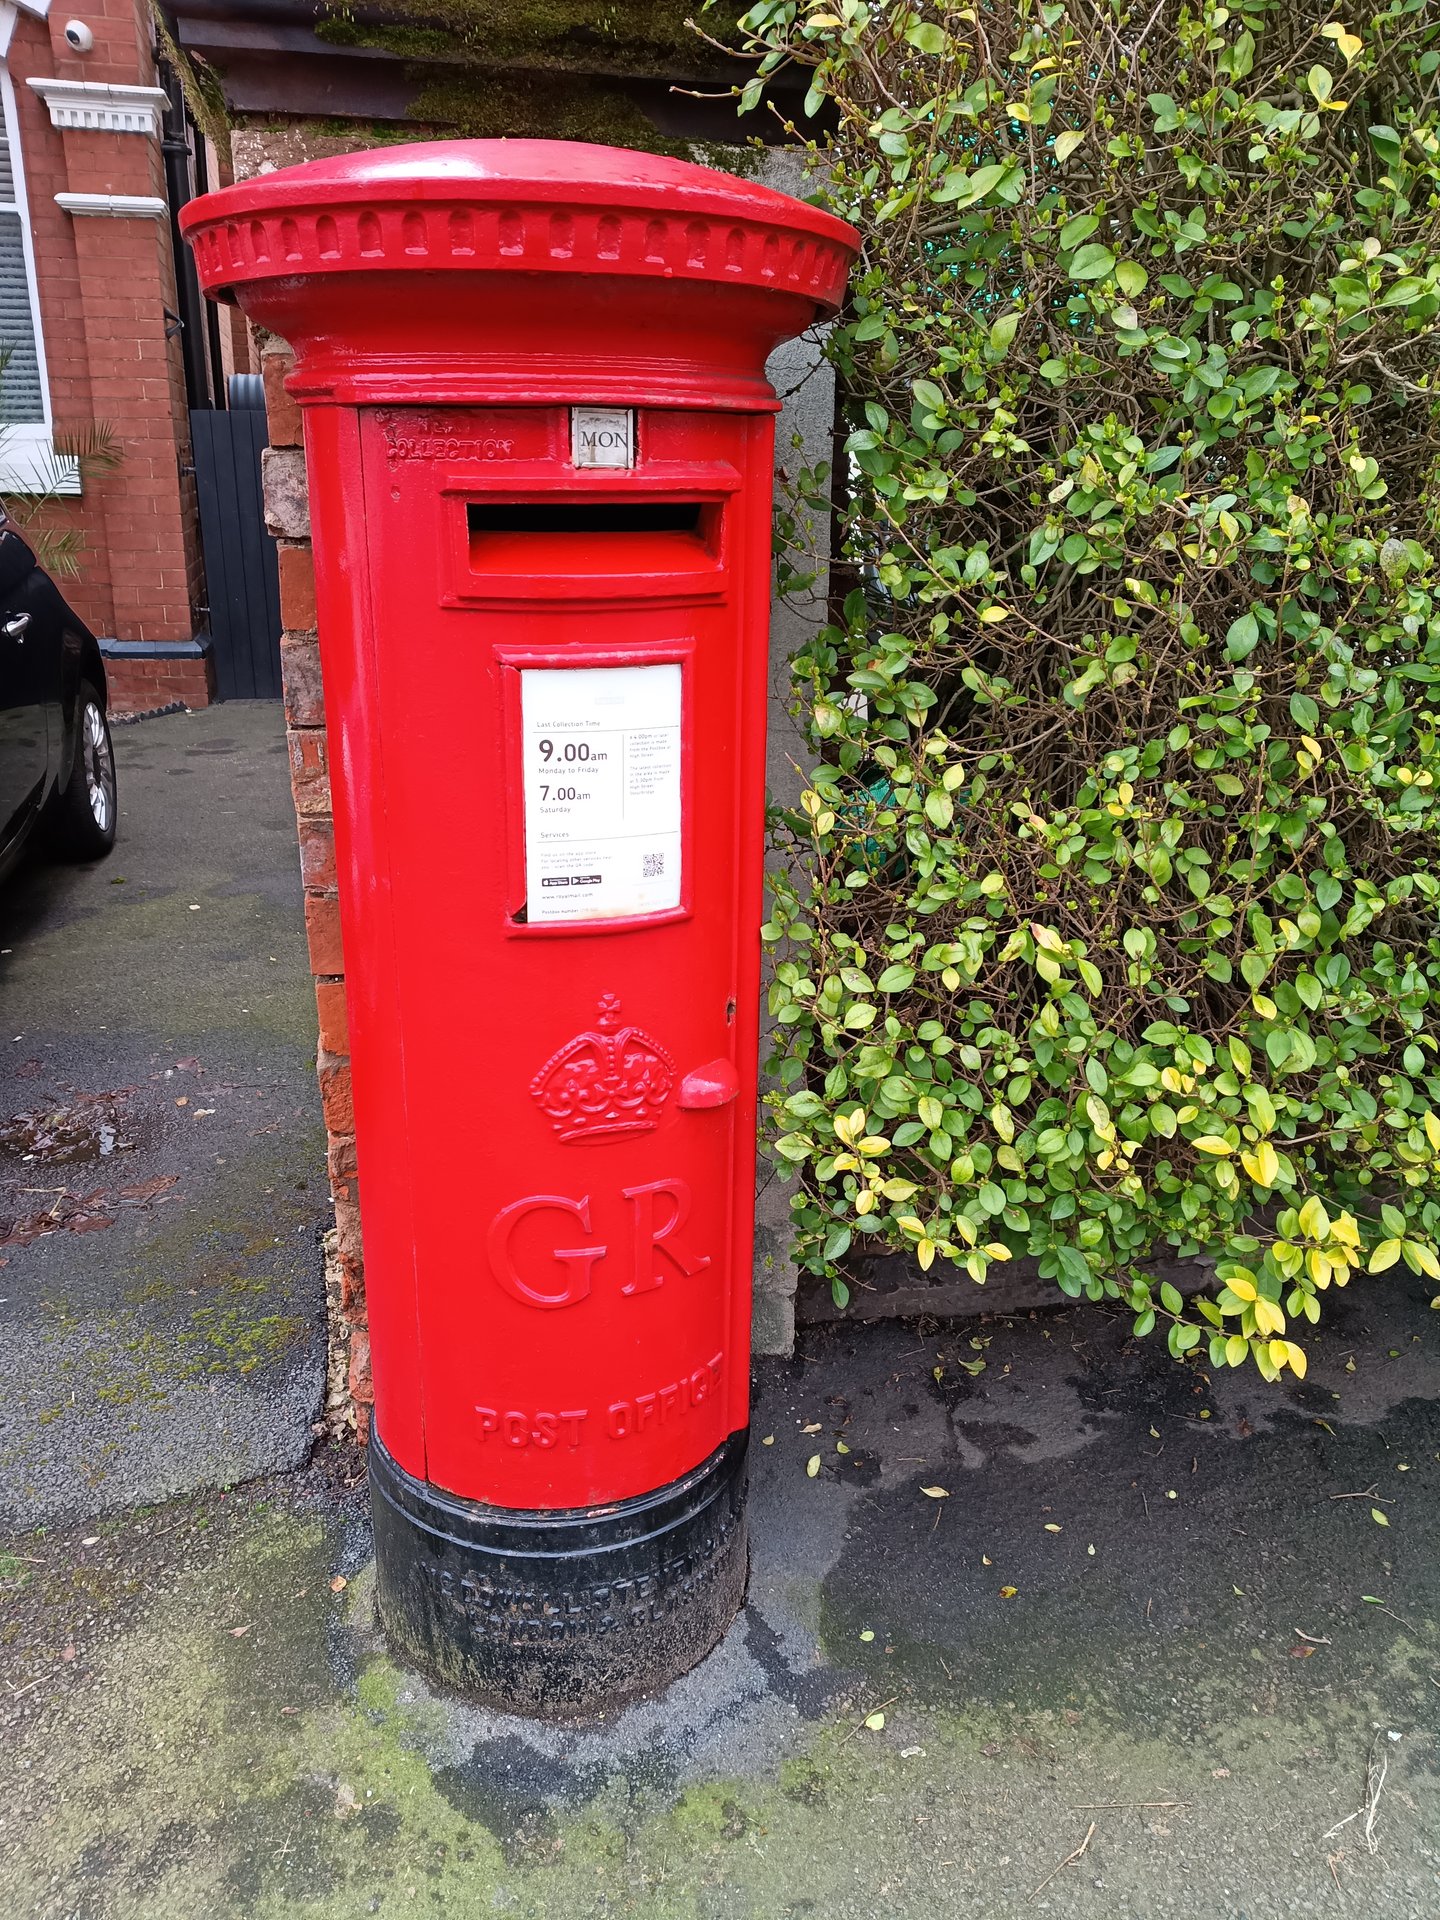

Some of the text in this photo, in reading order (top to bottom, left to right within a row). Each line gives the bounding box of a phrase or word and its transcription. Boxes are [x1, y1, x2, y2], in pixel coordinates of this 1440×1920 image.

[580, 431, 629, 448] MON
[552, 720, 584, 728] Collection
[538, 739, 608, 762] 9.00am
[538, 767, 566, 775] Monday
[577, 766, 599, 774] Friday
[539, 785, 591, 801] 7.00am
[539, 806, 571, 814] Saturday
[540, 831, 569, 839] Services
[475, 1352, 723, 1449] POST OFFICE
